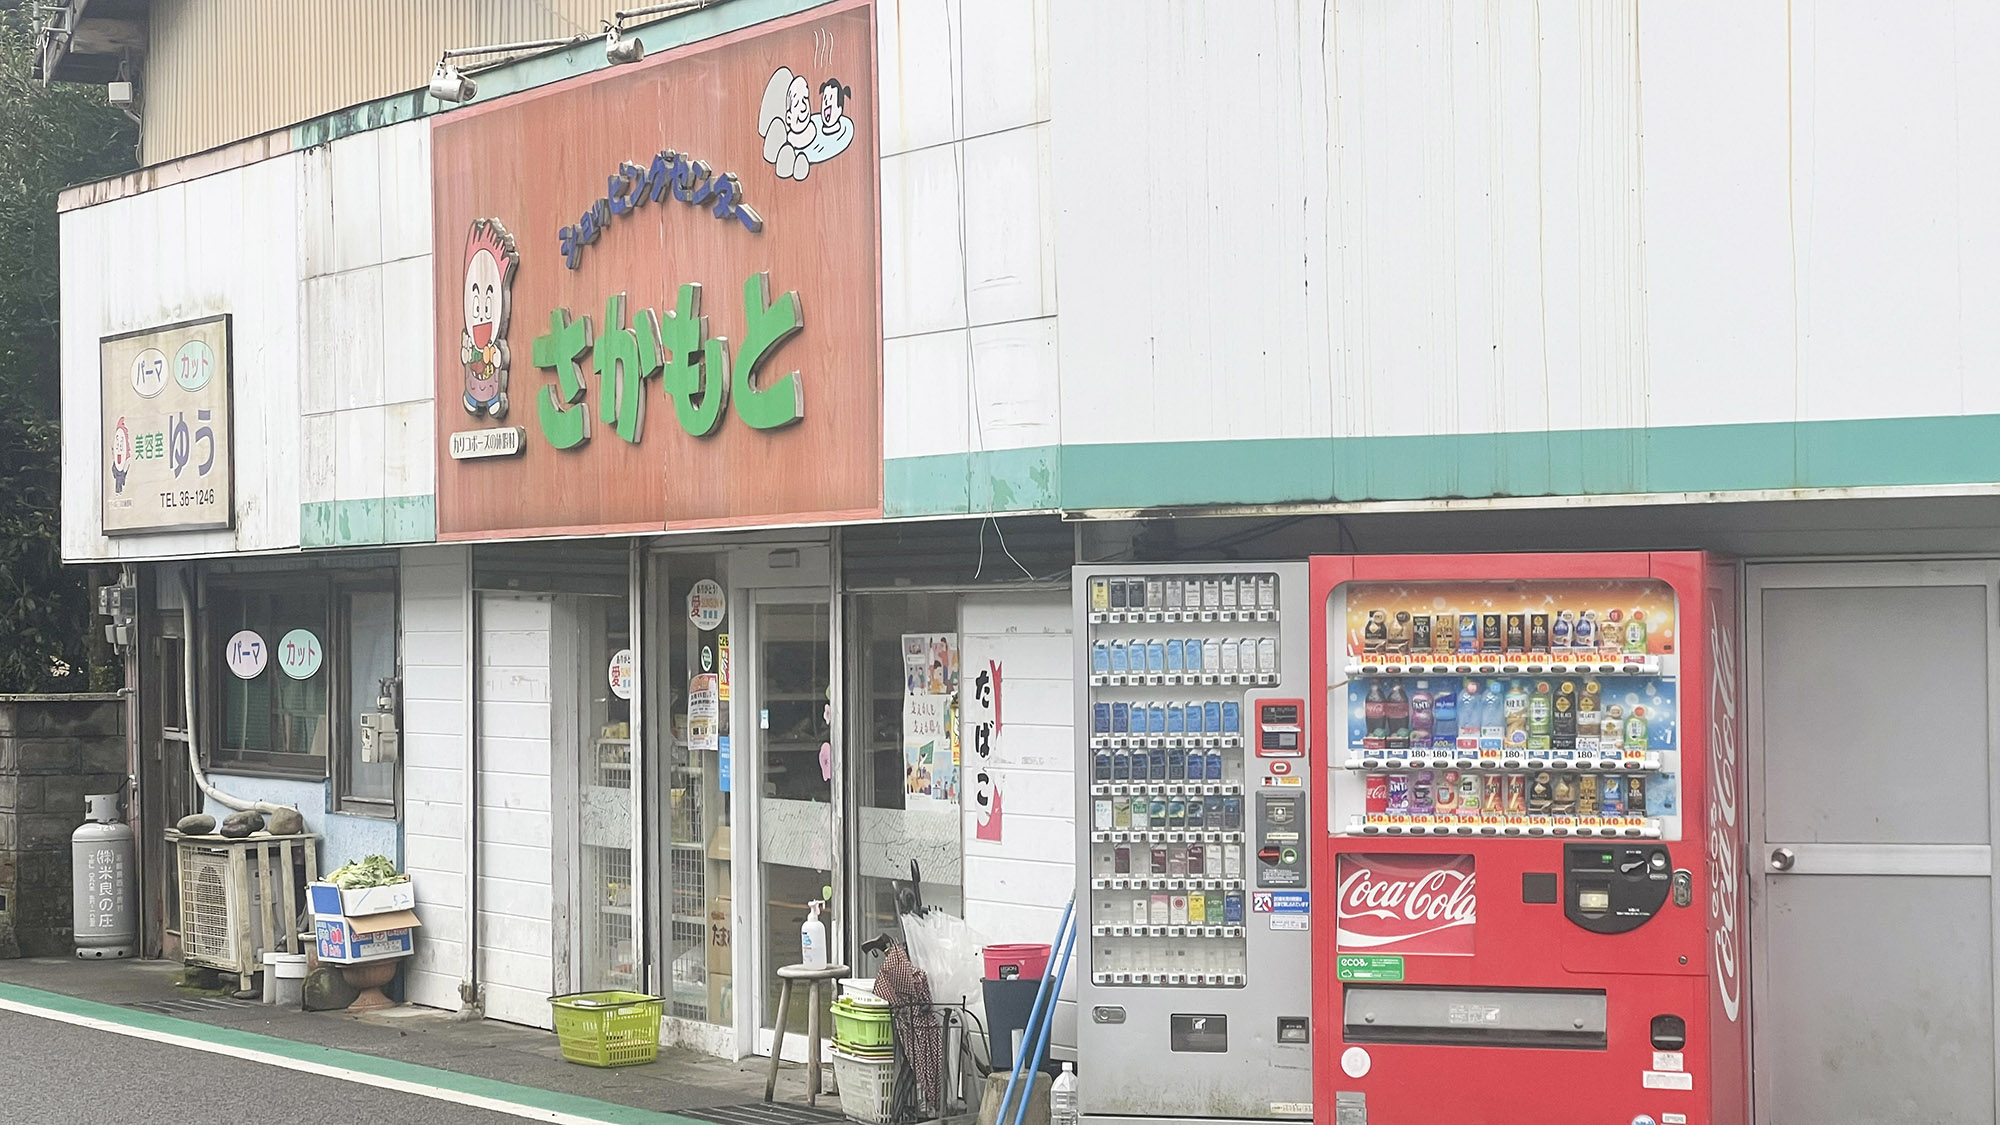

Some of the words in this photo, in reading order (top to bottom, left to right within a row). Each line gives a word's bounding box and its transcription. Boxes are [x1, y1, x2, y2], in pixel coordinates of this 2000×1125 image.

[558, 148, 763, 269] ショッピングセンター
[136, 359, 163, 386] パーマ
[180, 351, 209, 379] カット
[532, 270, 804, 449] さかもと
[135, 431, 164, 460] 美容室
[168, 409, 215, 479] ゆう
[160, 491, 178, 508] TEL
[179, 488, 215, 507] 36-1246
[691, 595, 700, 618] 愛
[232, 640, 260, 665] パーマ
[286, 640, 316, 666] カット
[612, 666, 620, 687] 愛
[975, 670, 994, 807] たばこ
[1254, 896, 1272, 912] 20
[1338, 869, 1476, 920] Coca-Cola
